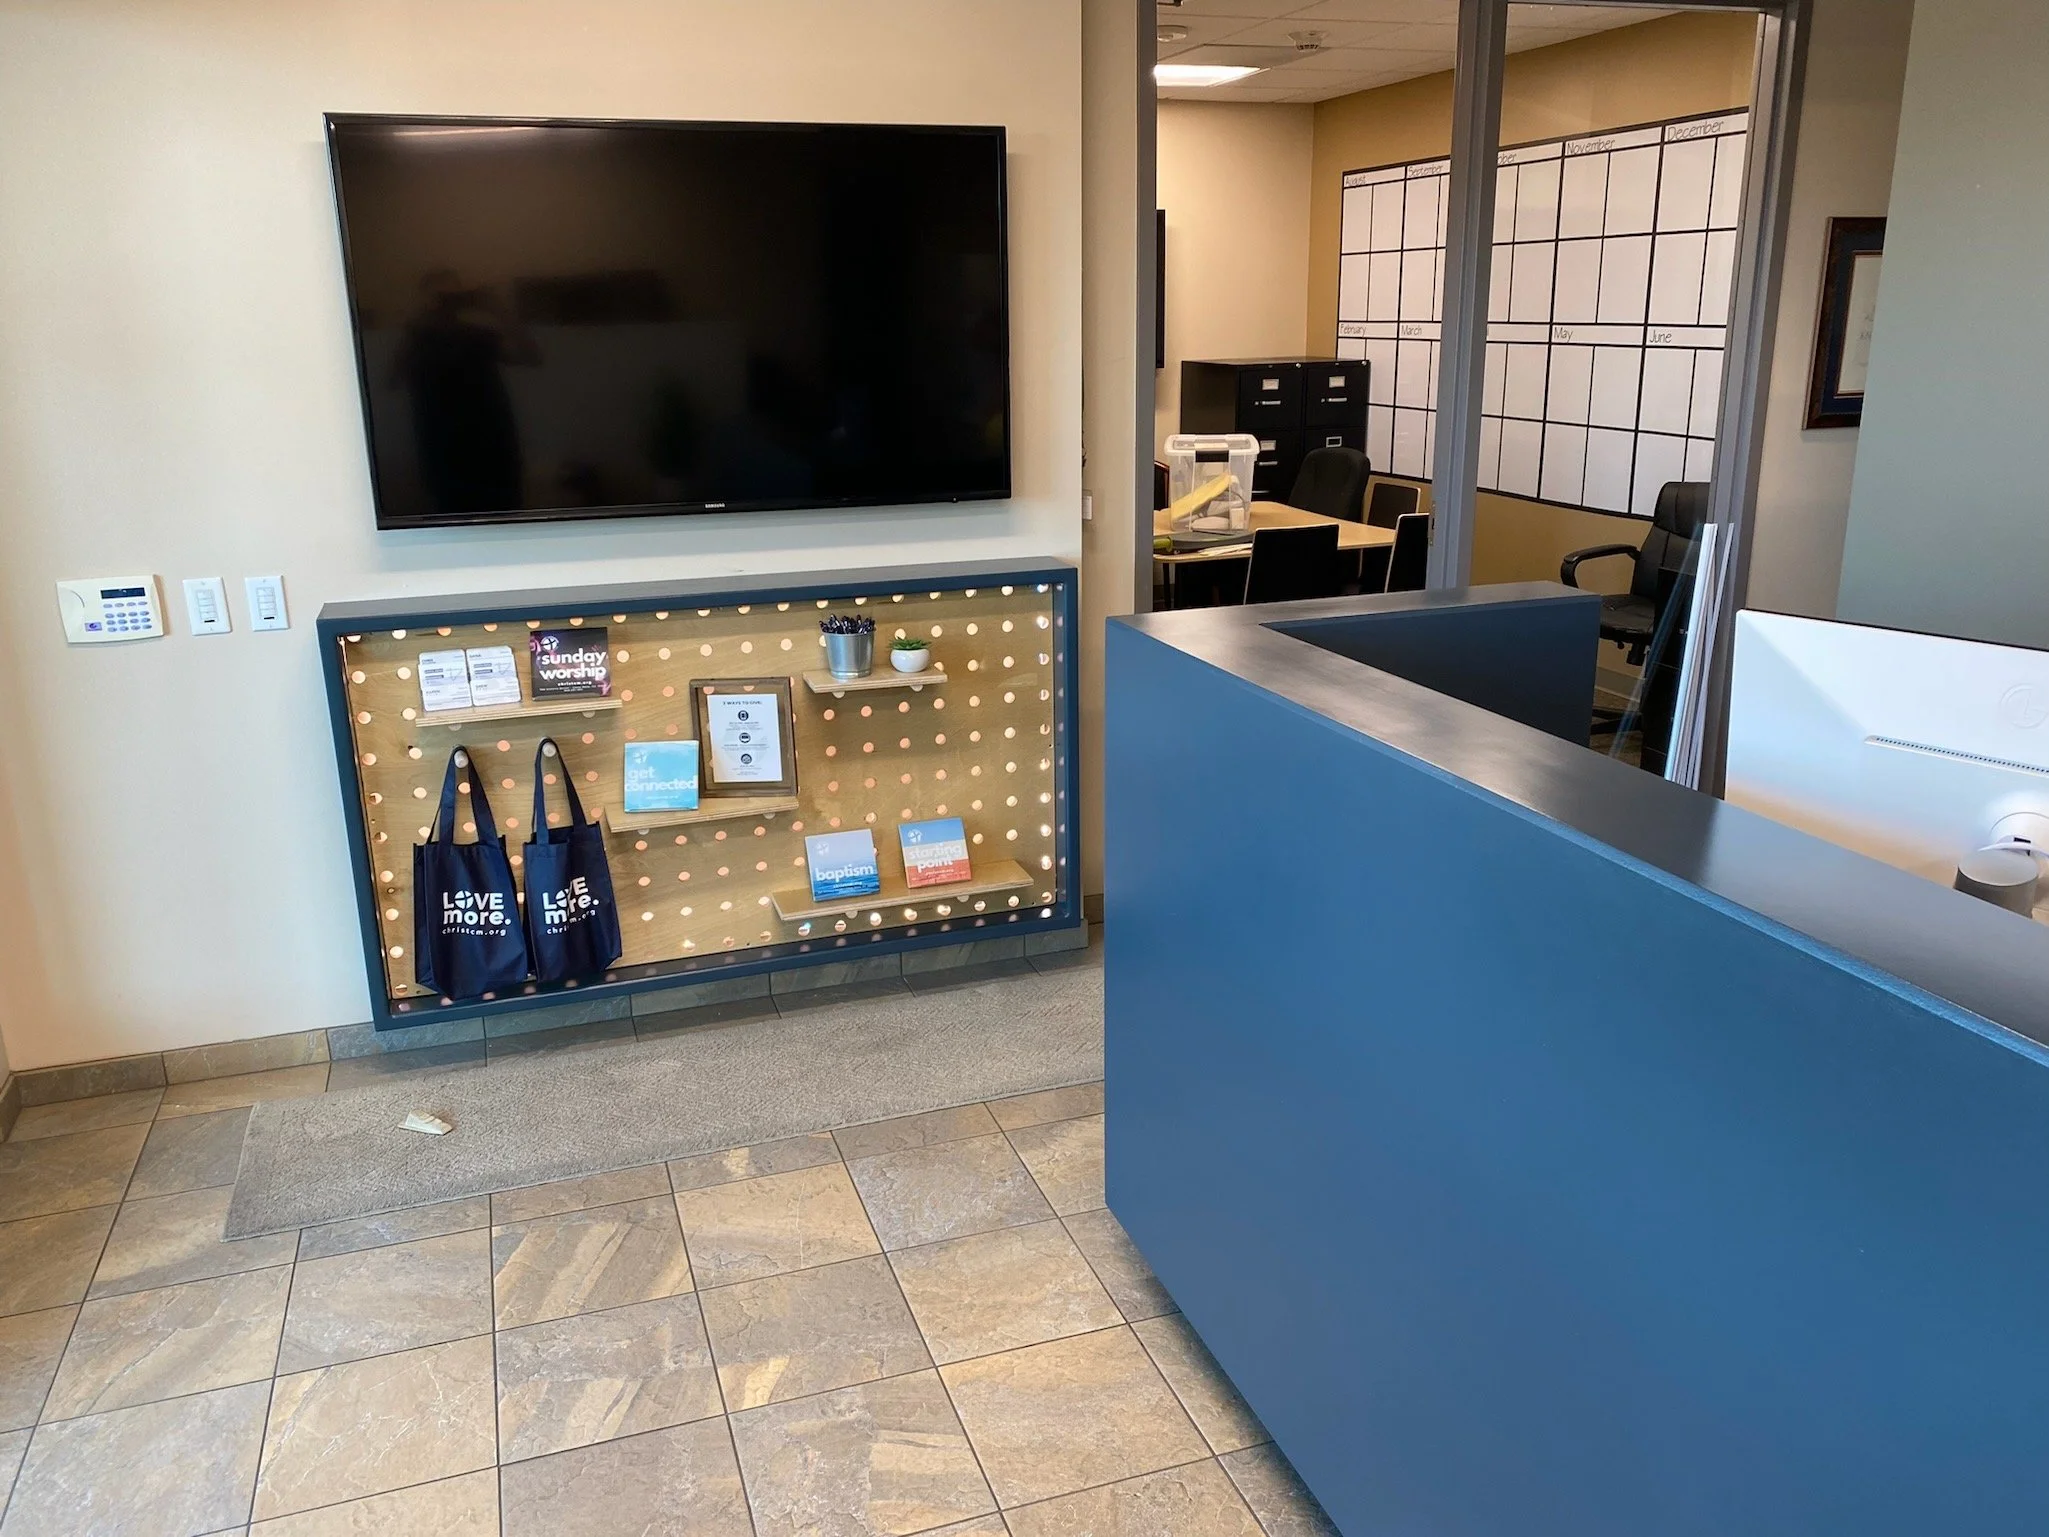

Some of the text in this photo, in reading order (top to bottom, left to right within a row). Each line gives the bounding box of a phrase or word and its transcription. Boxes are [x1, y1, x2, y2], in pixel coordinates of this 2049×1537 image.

[1667, 121, 1724, 141] December
[1566, 139, 1615, 154] November
[1408, 164, 1443, 177] September
[1340, 324, 1366, 338] February
[1401, 324, 1422, 335] March
[1554, 327, 1573, 343] May
[1650, 330, 1672, 344] June
[541, 647, 607, 665] sunday
[539, 663, 607, 682] worship
[625, 775, 698, 791] connected
[627, 766, 655, 783] get
[909, 841, 962, 859] starting
[815, 864, 874, 882] baptism
[917, 856, 953, 873] point
[443, 909, 511, 926] more.
[545, 894, 599, 925] mre.
[547, 909, 596, 934] chrim.org
[442, 926, 507, 936] christcm.org
